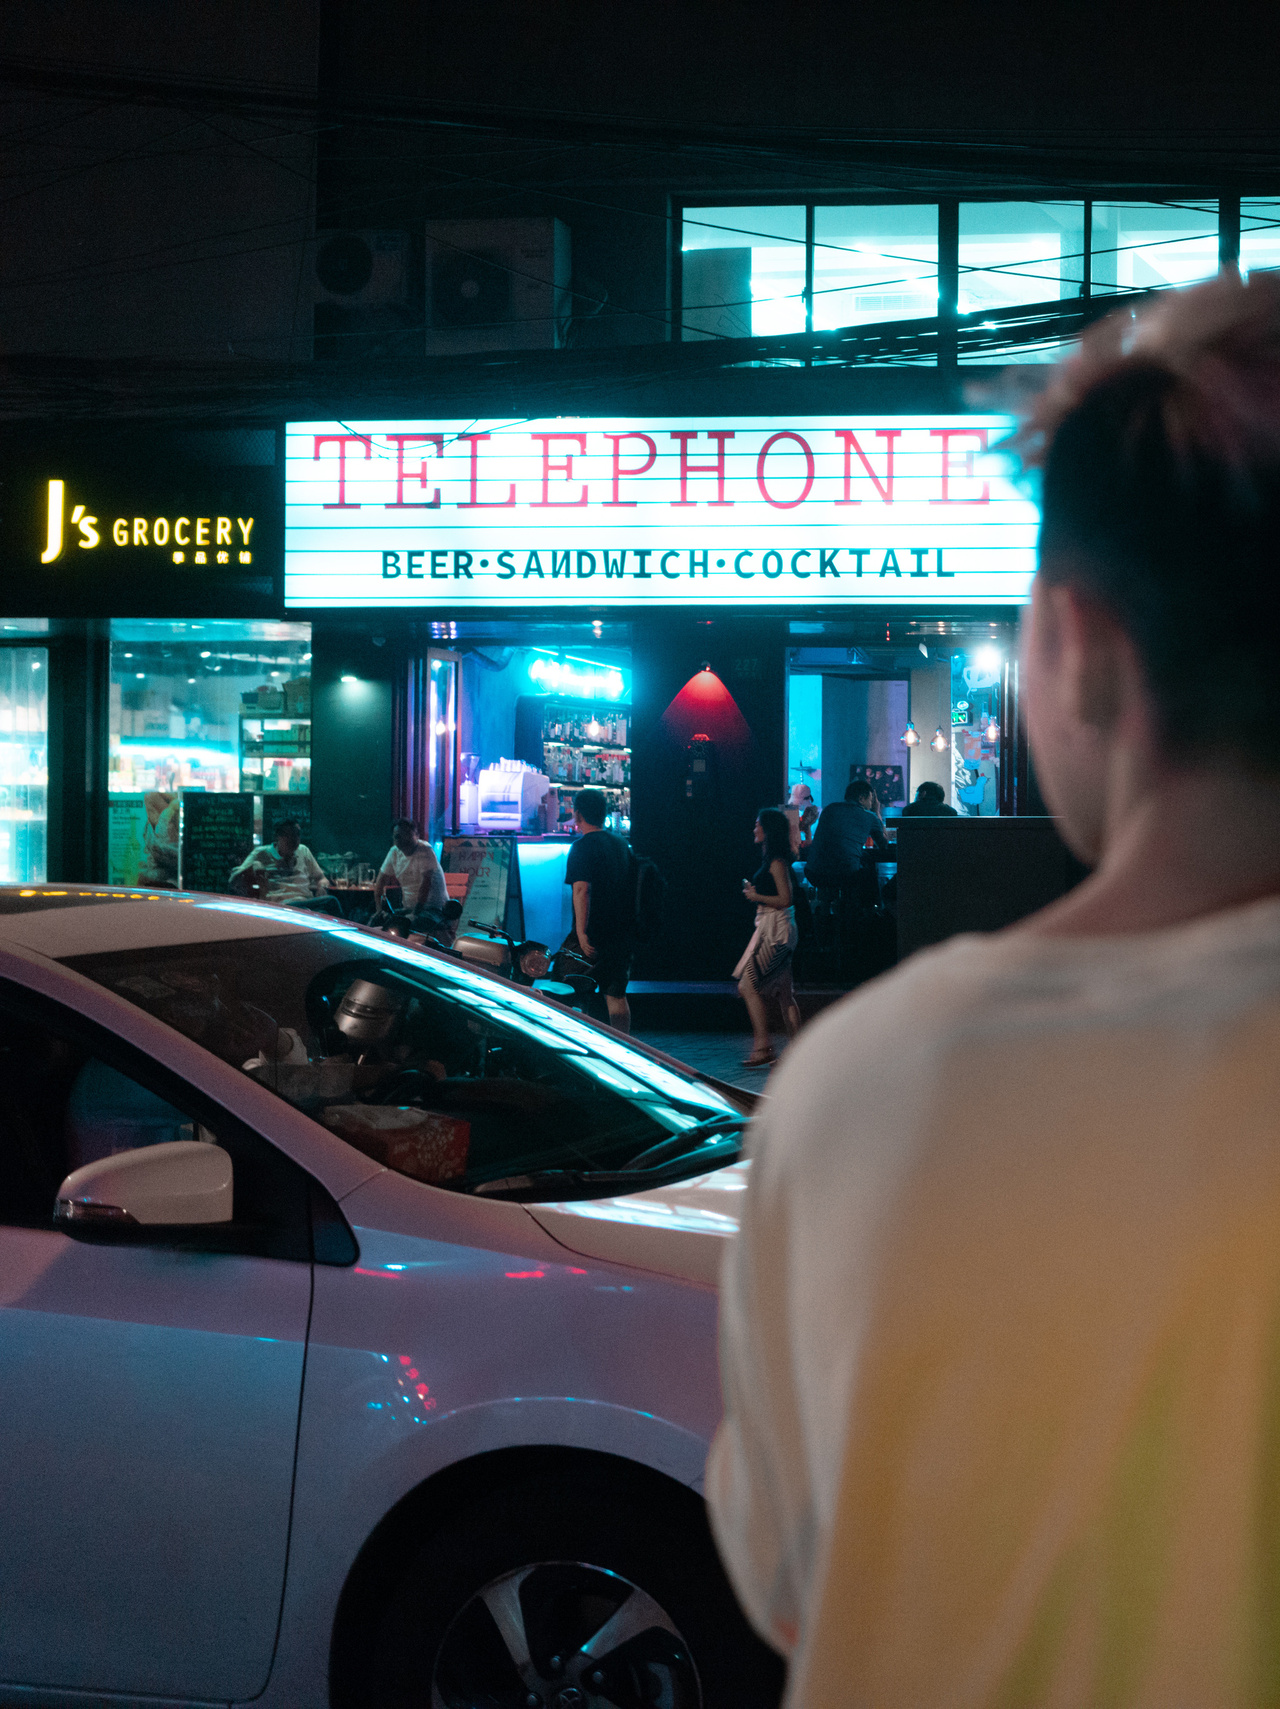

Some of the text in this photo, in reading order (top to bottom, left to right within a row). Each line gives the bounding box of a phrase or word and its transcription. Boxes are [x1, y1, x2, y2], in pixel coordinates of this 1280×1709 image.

[312, 432, 991, 510] TELEPHONE
[41, 480, 254, 564] J's GROCERY
